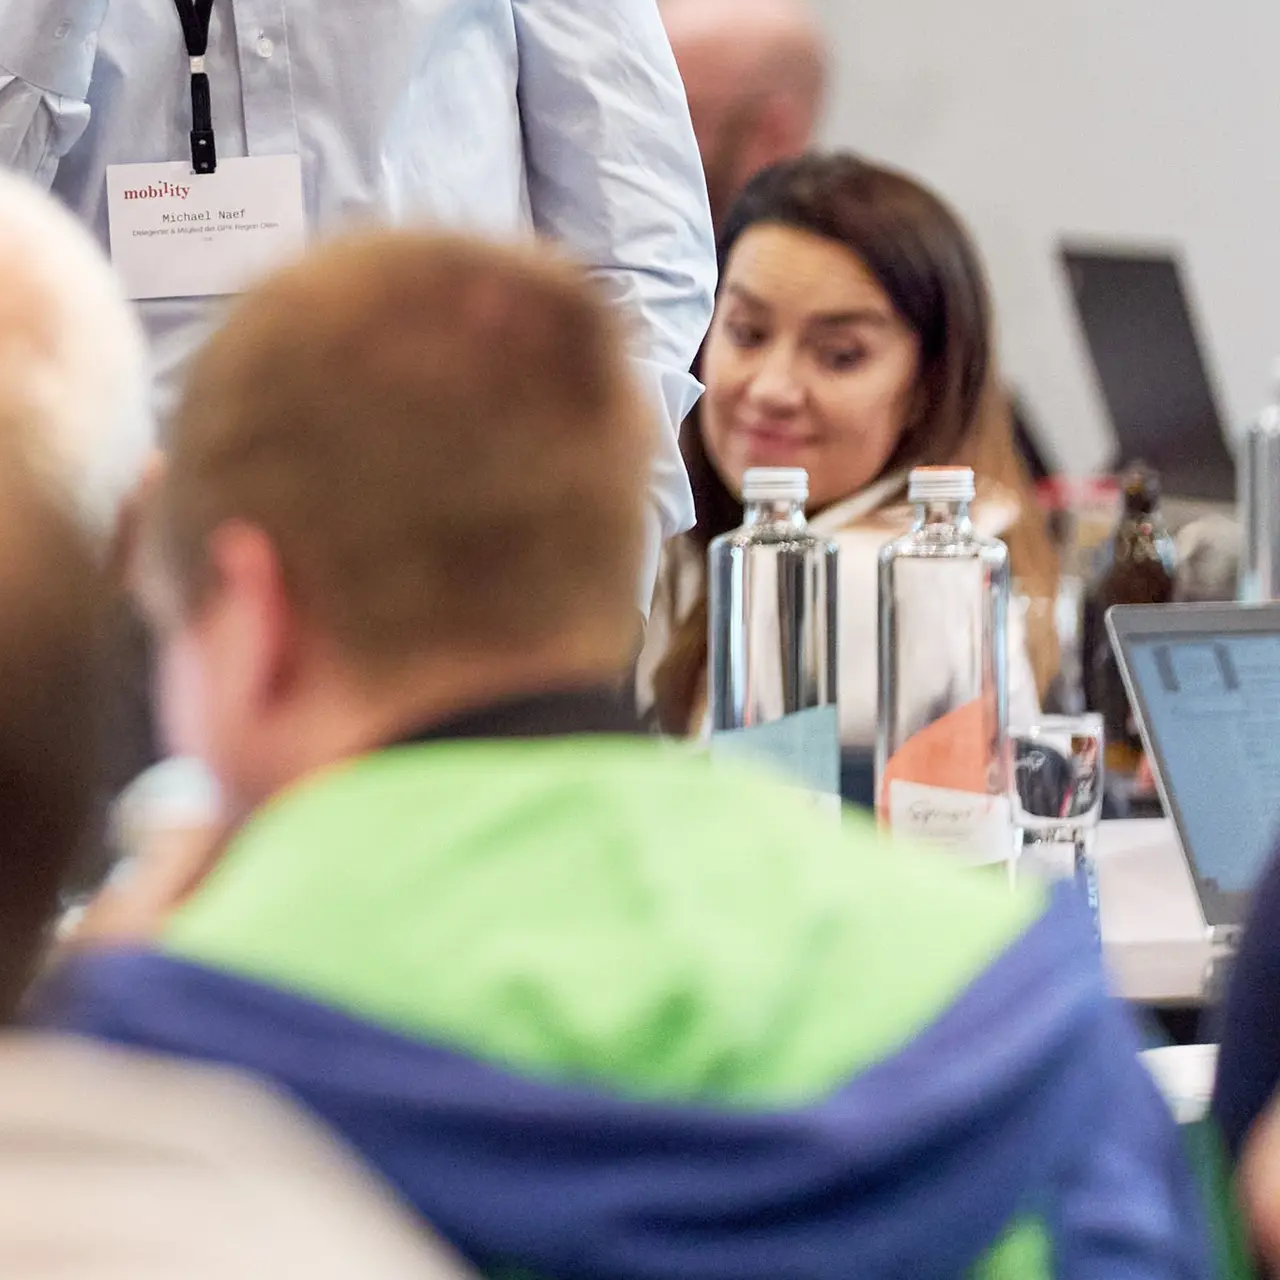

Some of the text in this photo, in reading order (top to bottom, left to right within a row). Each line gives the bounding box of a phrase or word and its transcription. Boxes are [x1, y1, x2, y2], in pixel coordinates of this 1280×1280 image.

[124, 180, 190, 200] mobility
[162, 209, 246, 223] Michael Naef
